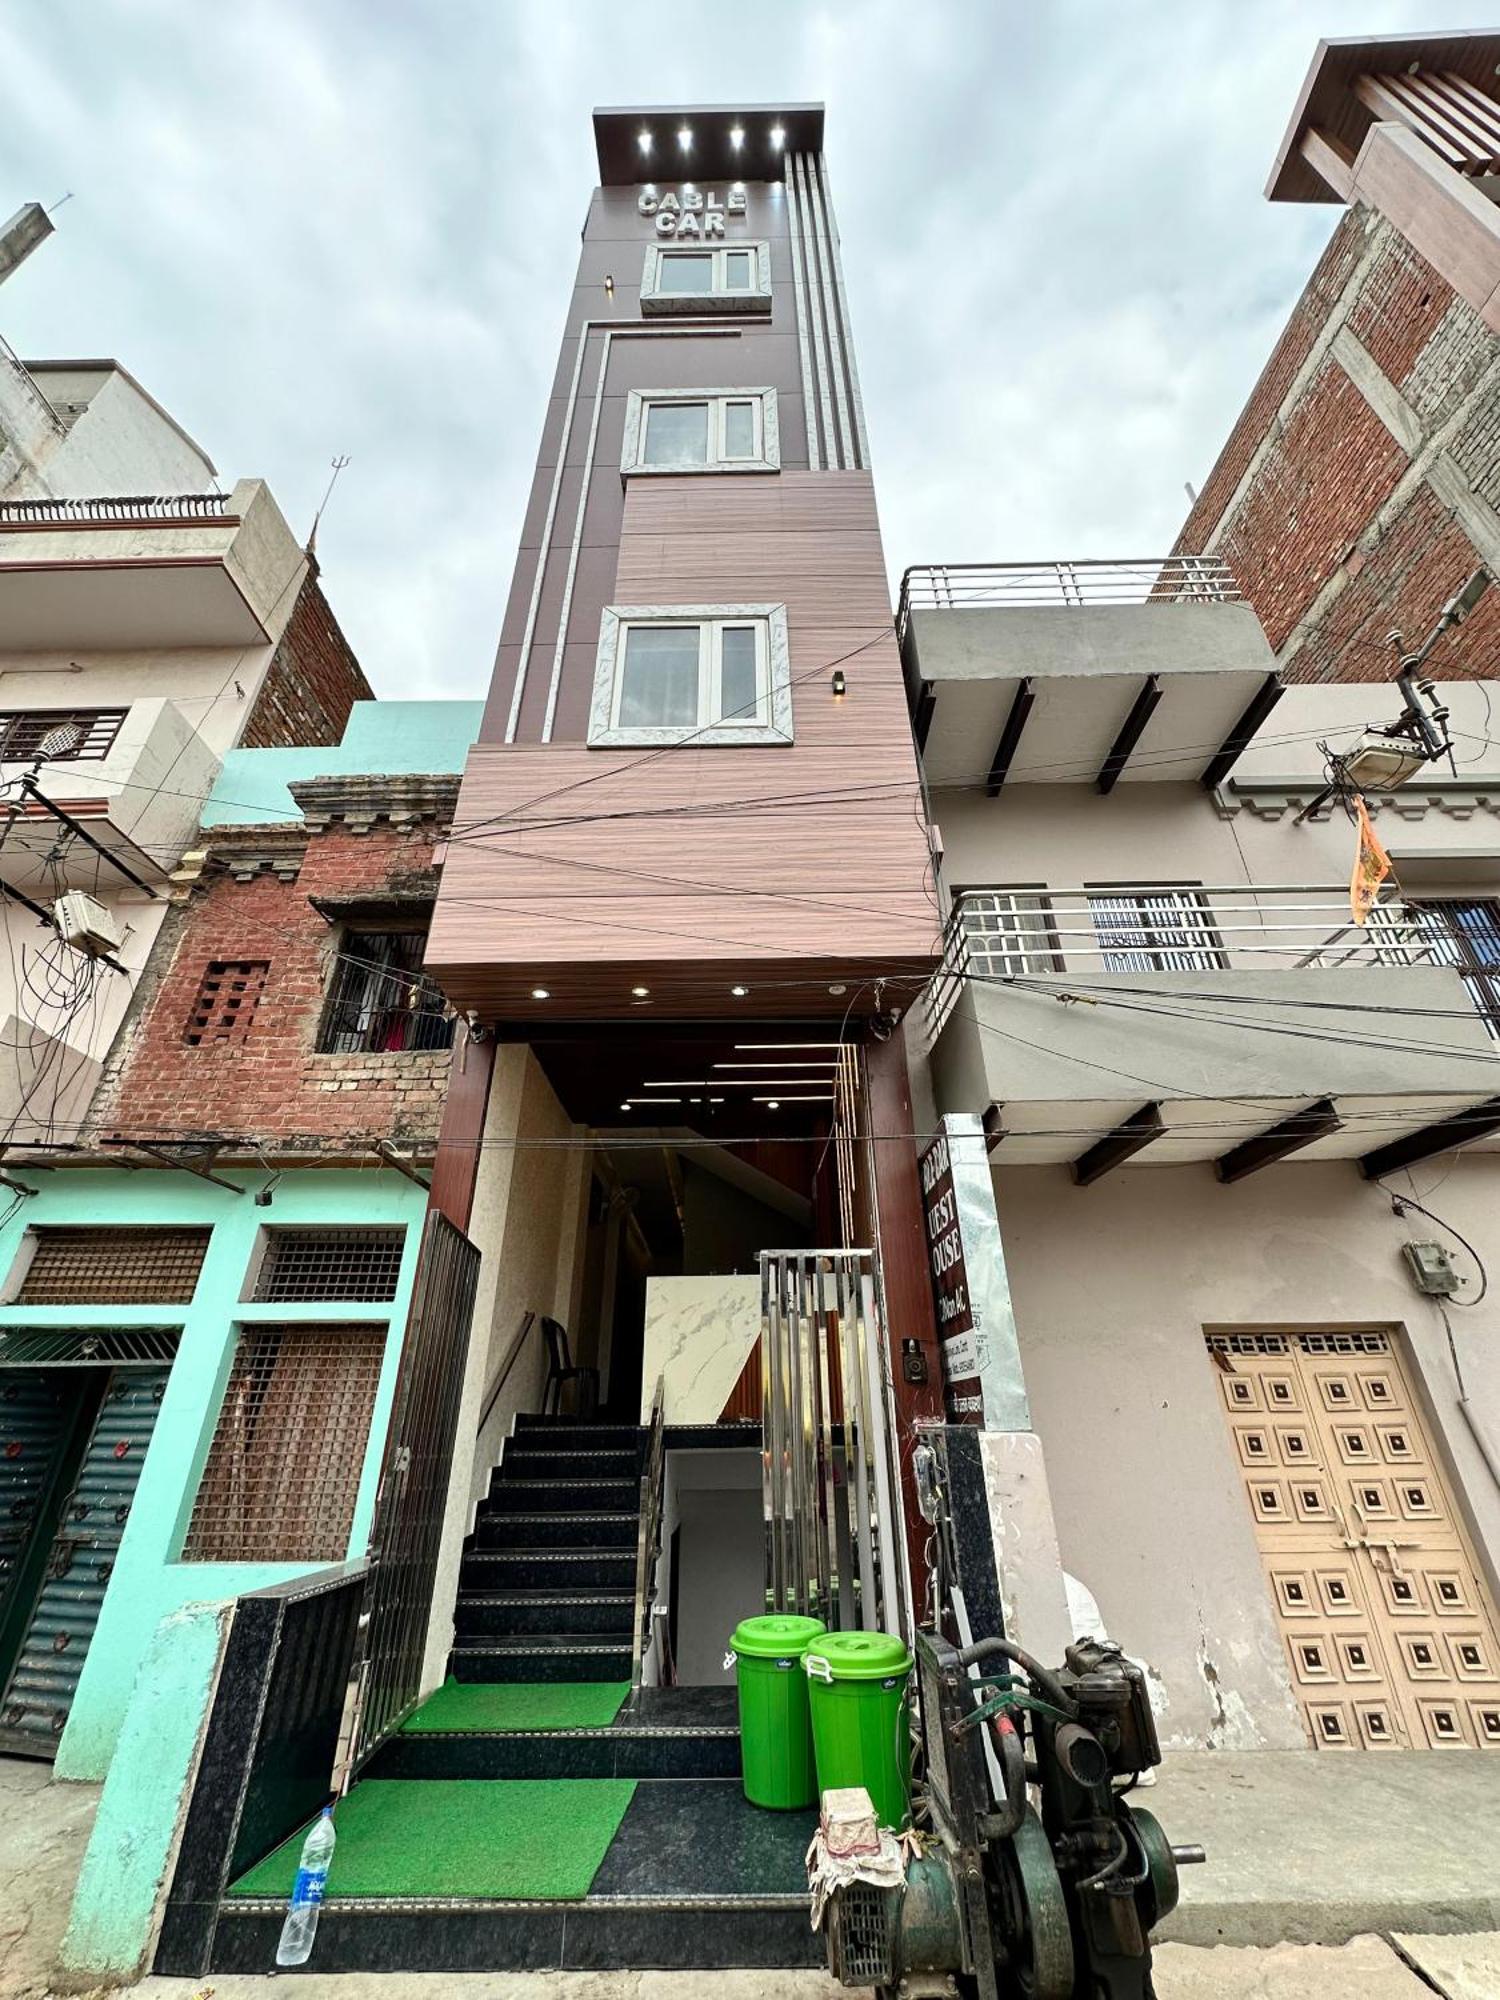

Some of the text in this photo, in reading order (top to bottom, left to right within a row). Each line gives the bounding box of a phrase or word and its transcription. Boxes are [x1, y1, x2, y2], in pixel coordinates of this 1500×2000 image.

[638, 191, 746, 215] CABLE
[655, 212, 725, 236] CAR
[928, 1188, 954, 1239] UEST
[933, 1228, 962, 1277] OUSE
